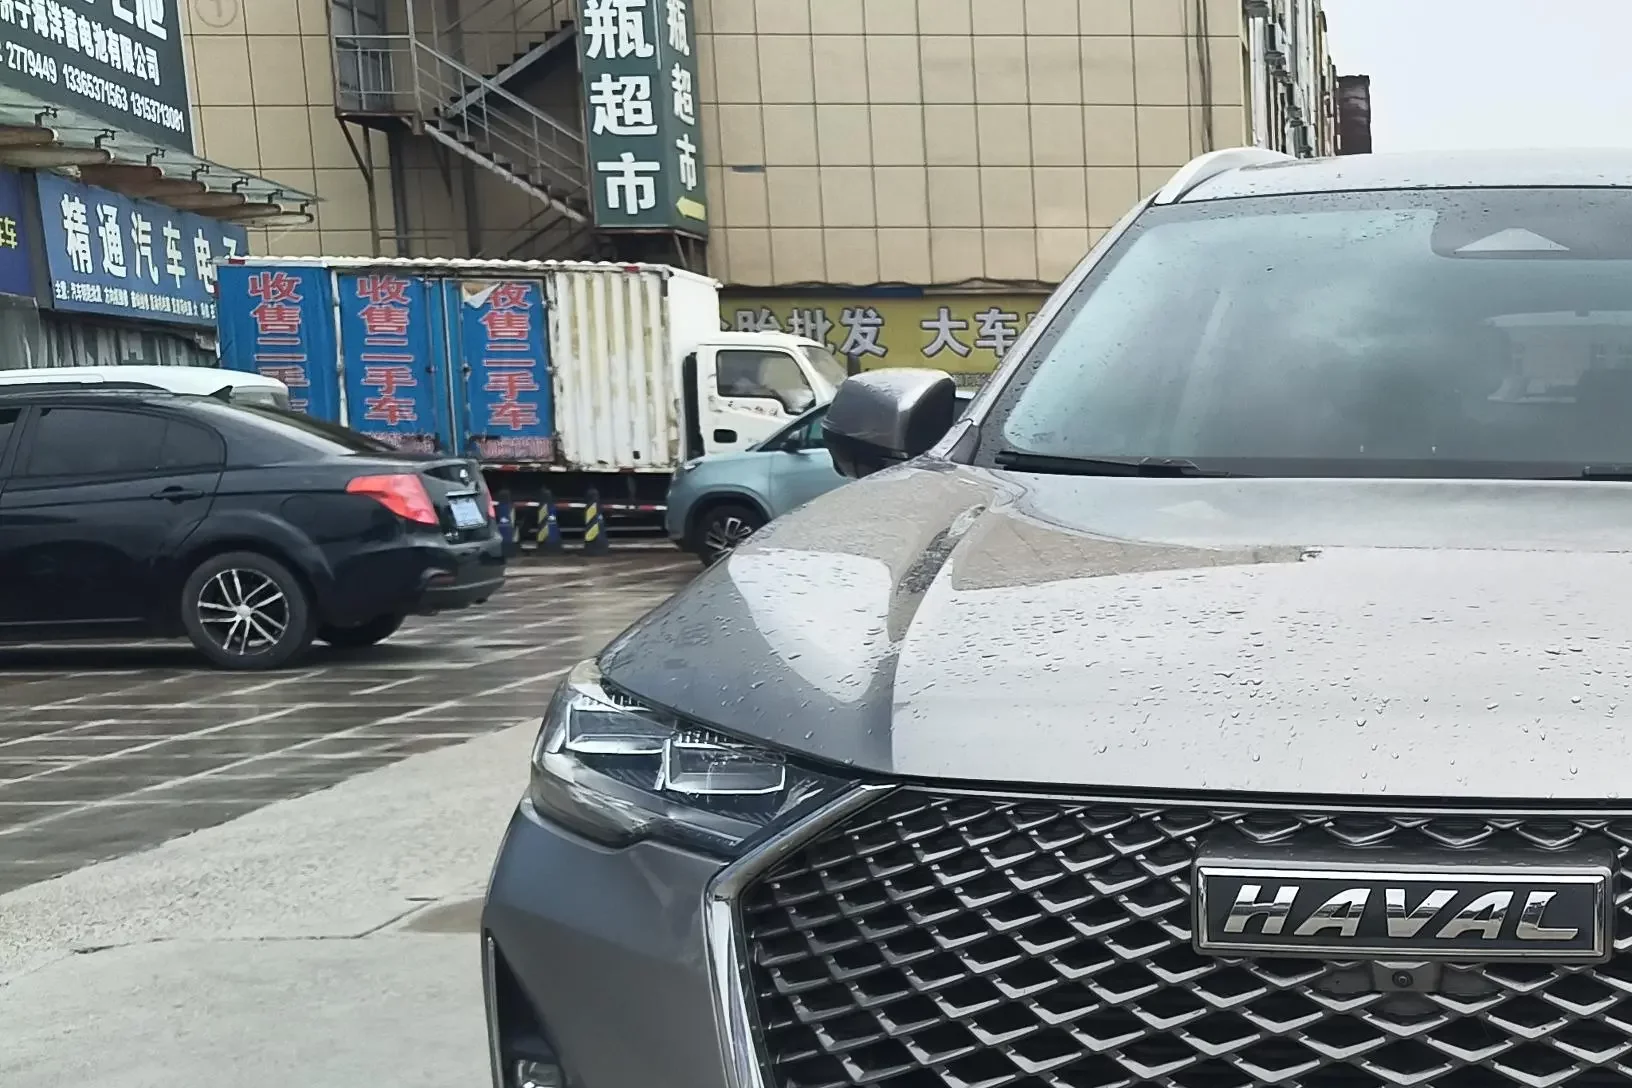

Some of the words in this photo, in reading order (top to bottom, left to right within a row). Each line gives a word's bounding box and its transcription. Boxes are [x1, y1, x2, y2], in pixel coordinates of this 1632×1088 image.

[6, 41, 58, 84] 2779449
[63, 63, 129, 112] 13365371563
[583, 0, 661, 215] 瓶超市
[248, 271, 312, 414] 收售二手
[356, 274, 418, 426] 收售二手车
[720, 306, 888, 358] 胎批发
[920, 307, 1040, 358] 大车
[1223, 884, 1580, 942] HAVAL
